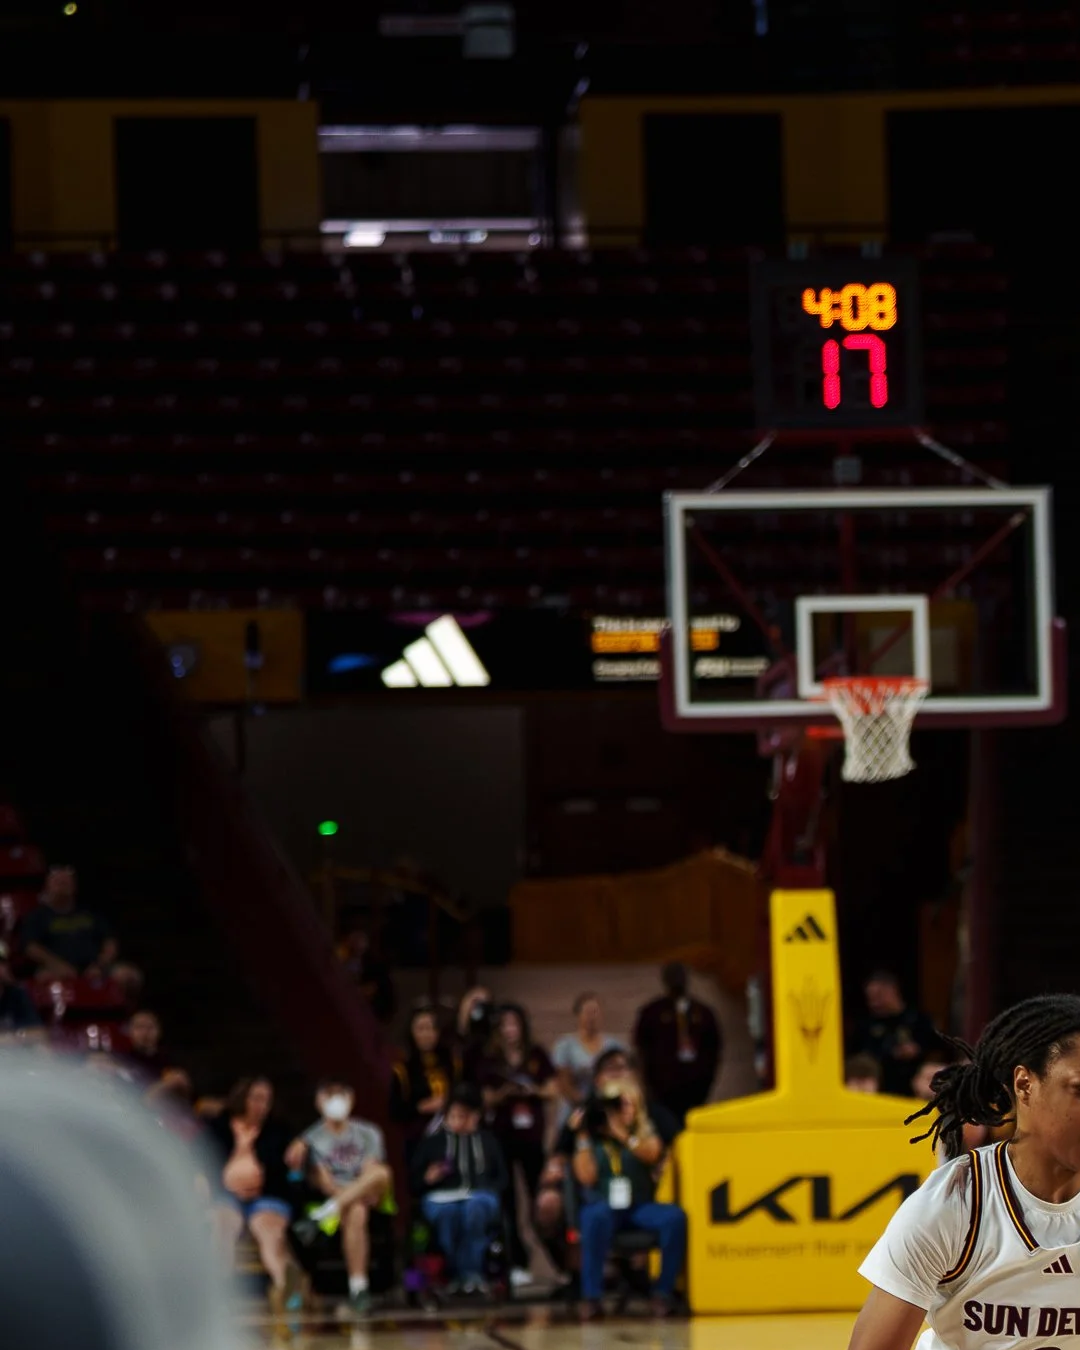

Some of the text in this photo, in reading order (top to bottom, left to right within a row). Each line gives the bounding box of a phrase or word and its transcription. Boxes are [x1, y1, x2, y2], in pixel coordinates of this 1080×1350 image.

[801, 282, 897, 331] 4:08
[822, 333, 889, 411] 17
[963, 1300, 1031, 1338] SUN
